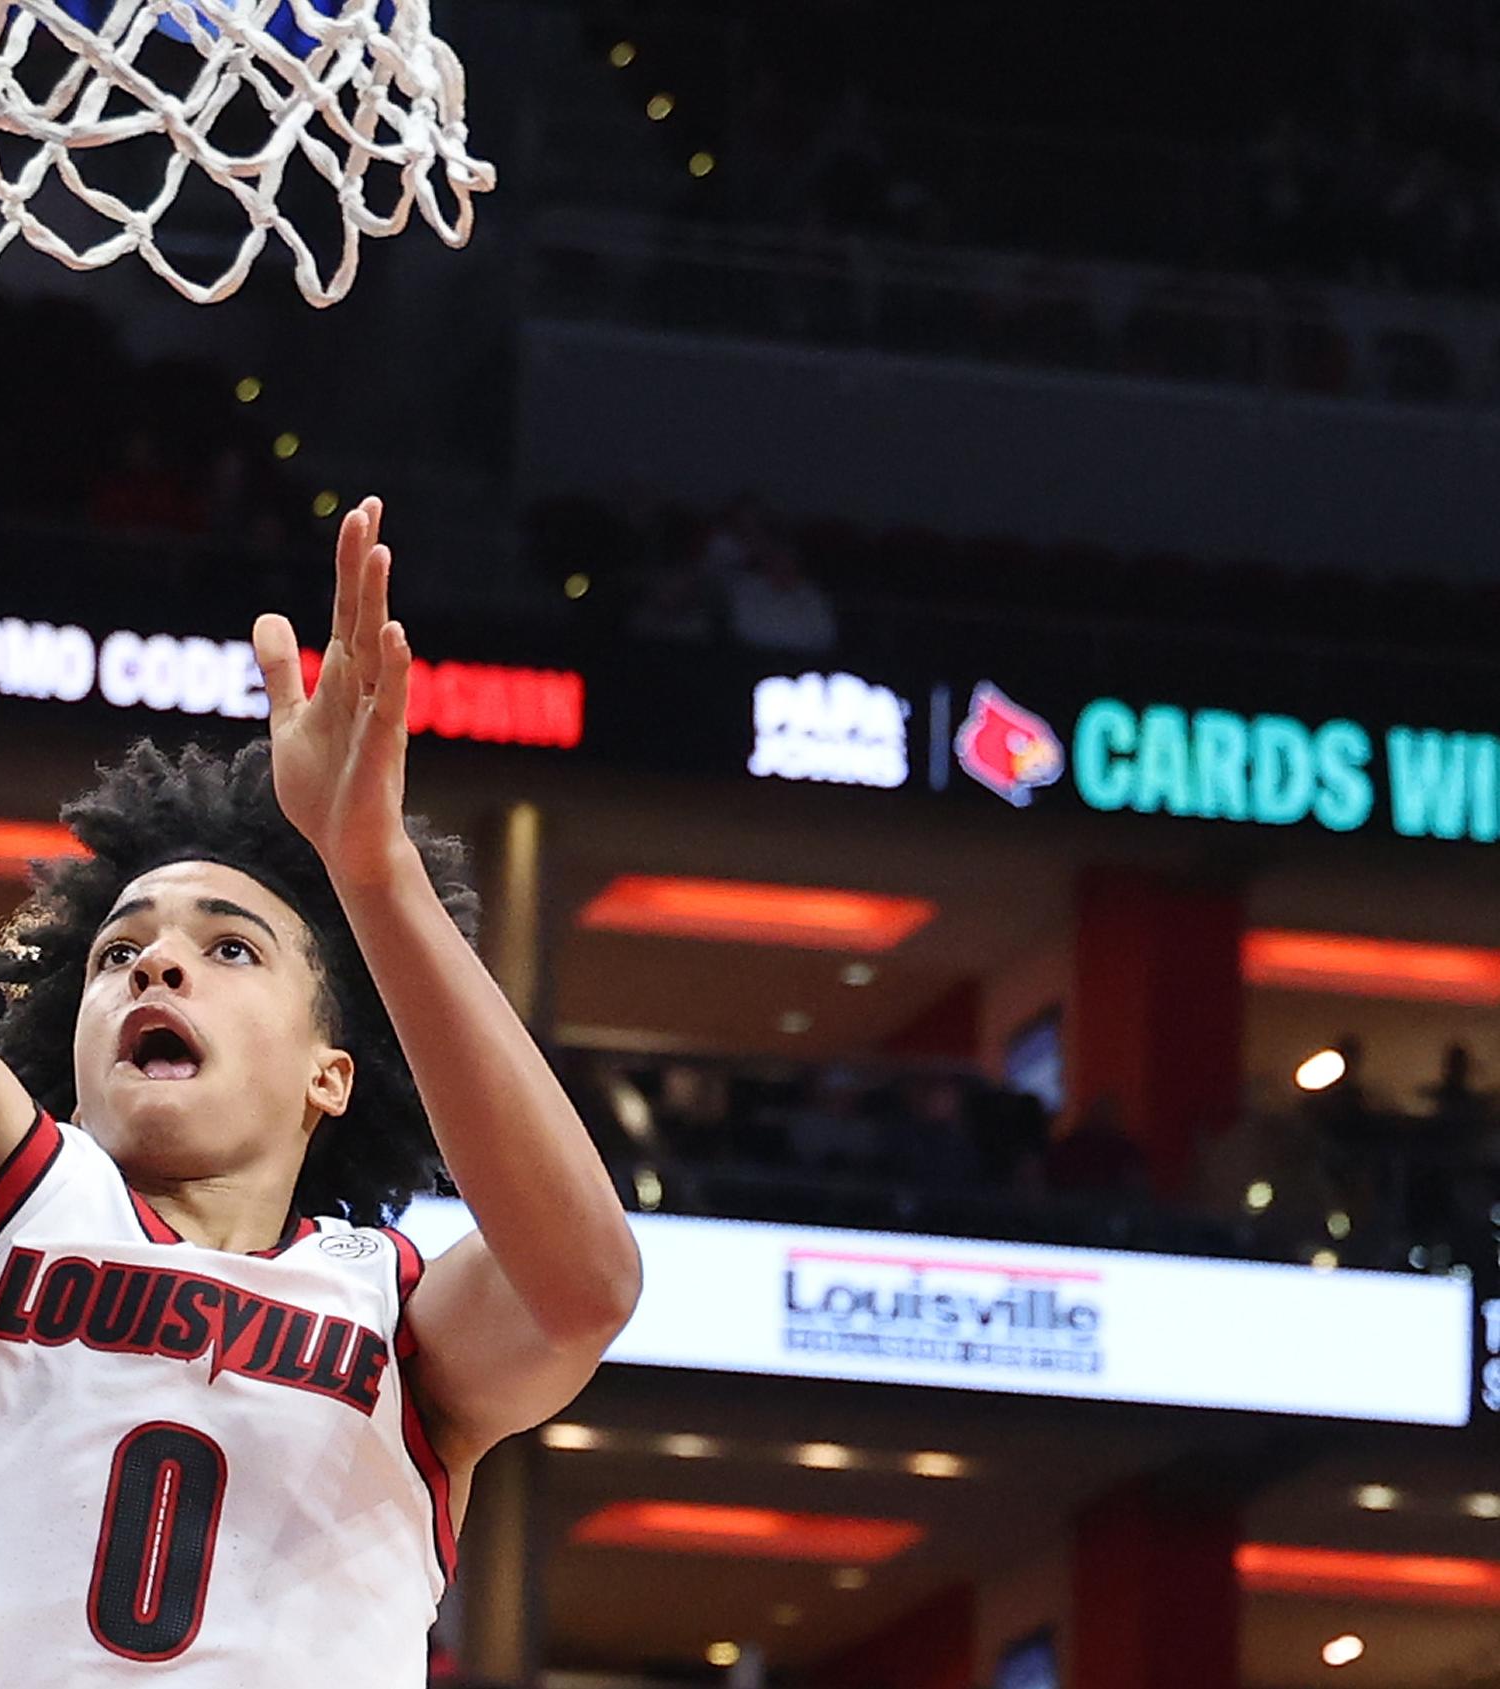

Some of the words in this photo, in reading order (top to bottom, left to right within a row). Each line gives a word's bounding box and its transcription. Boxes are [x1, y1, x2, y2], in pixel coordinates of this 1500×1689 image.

[1073, 699, 1374, 831] CARDS
[783, 1266, 1100, 1334] Louisville
[87, 1420, 228, 1662] 0
